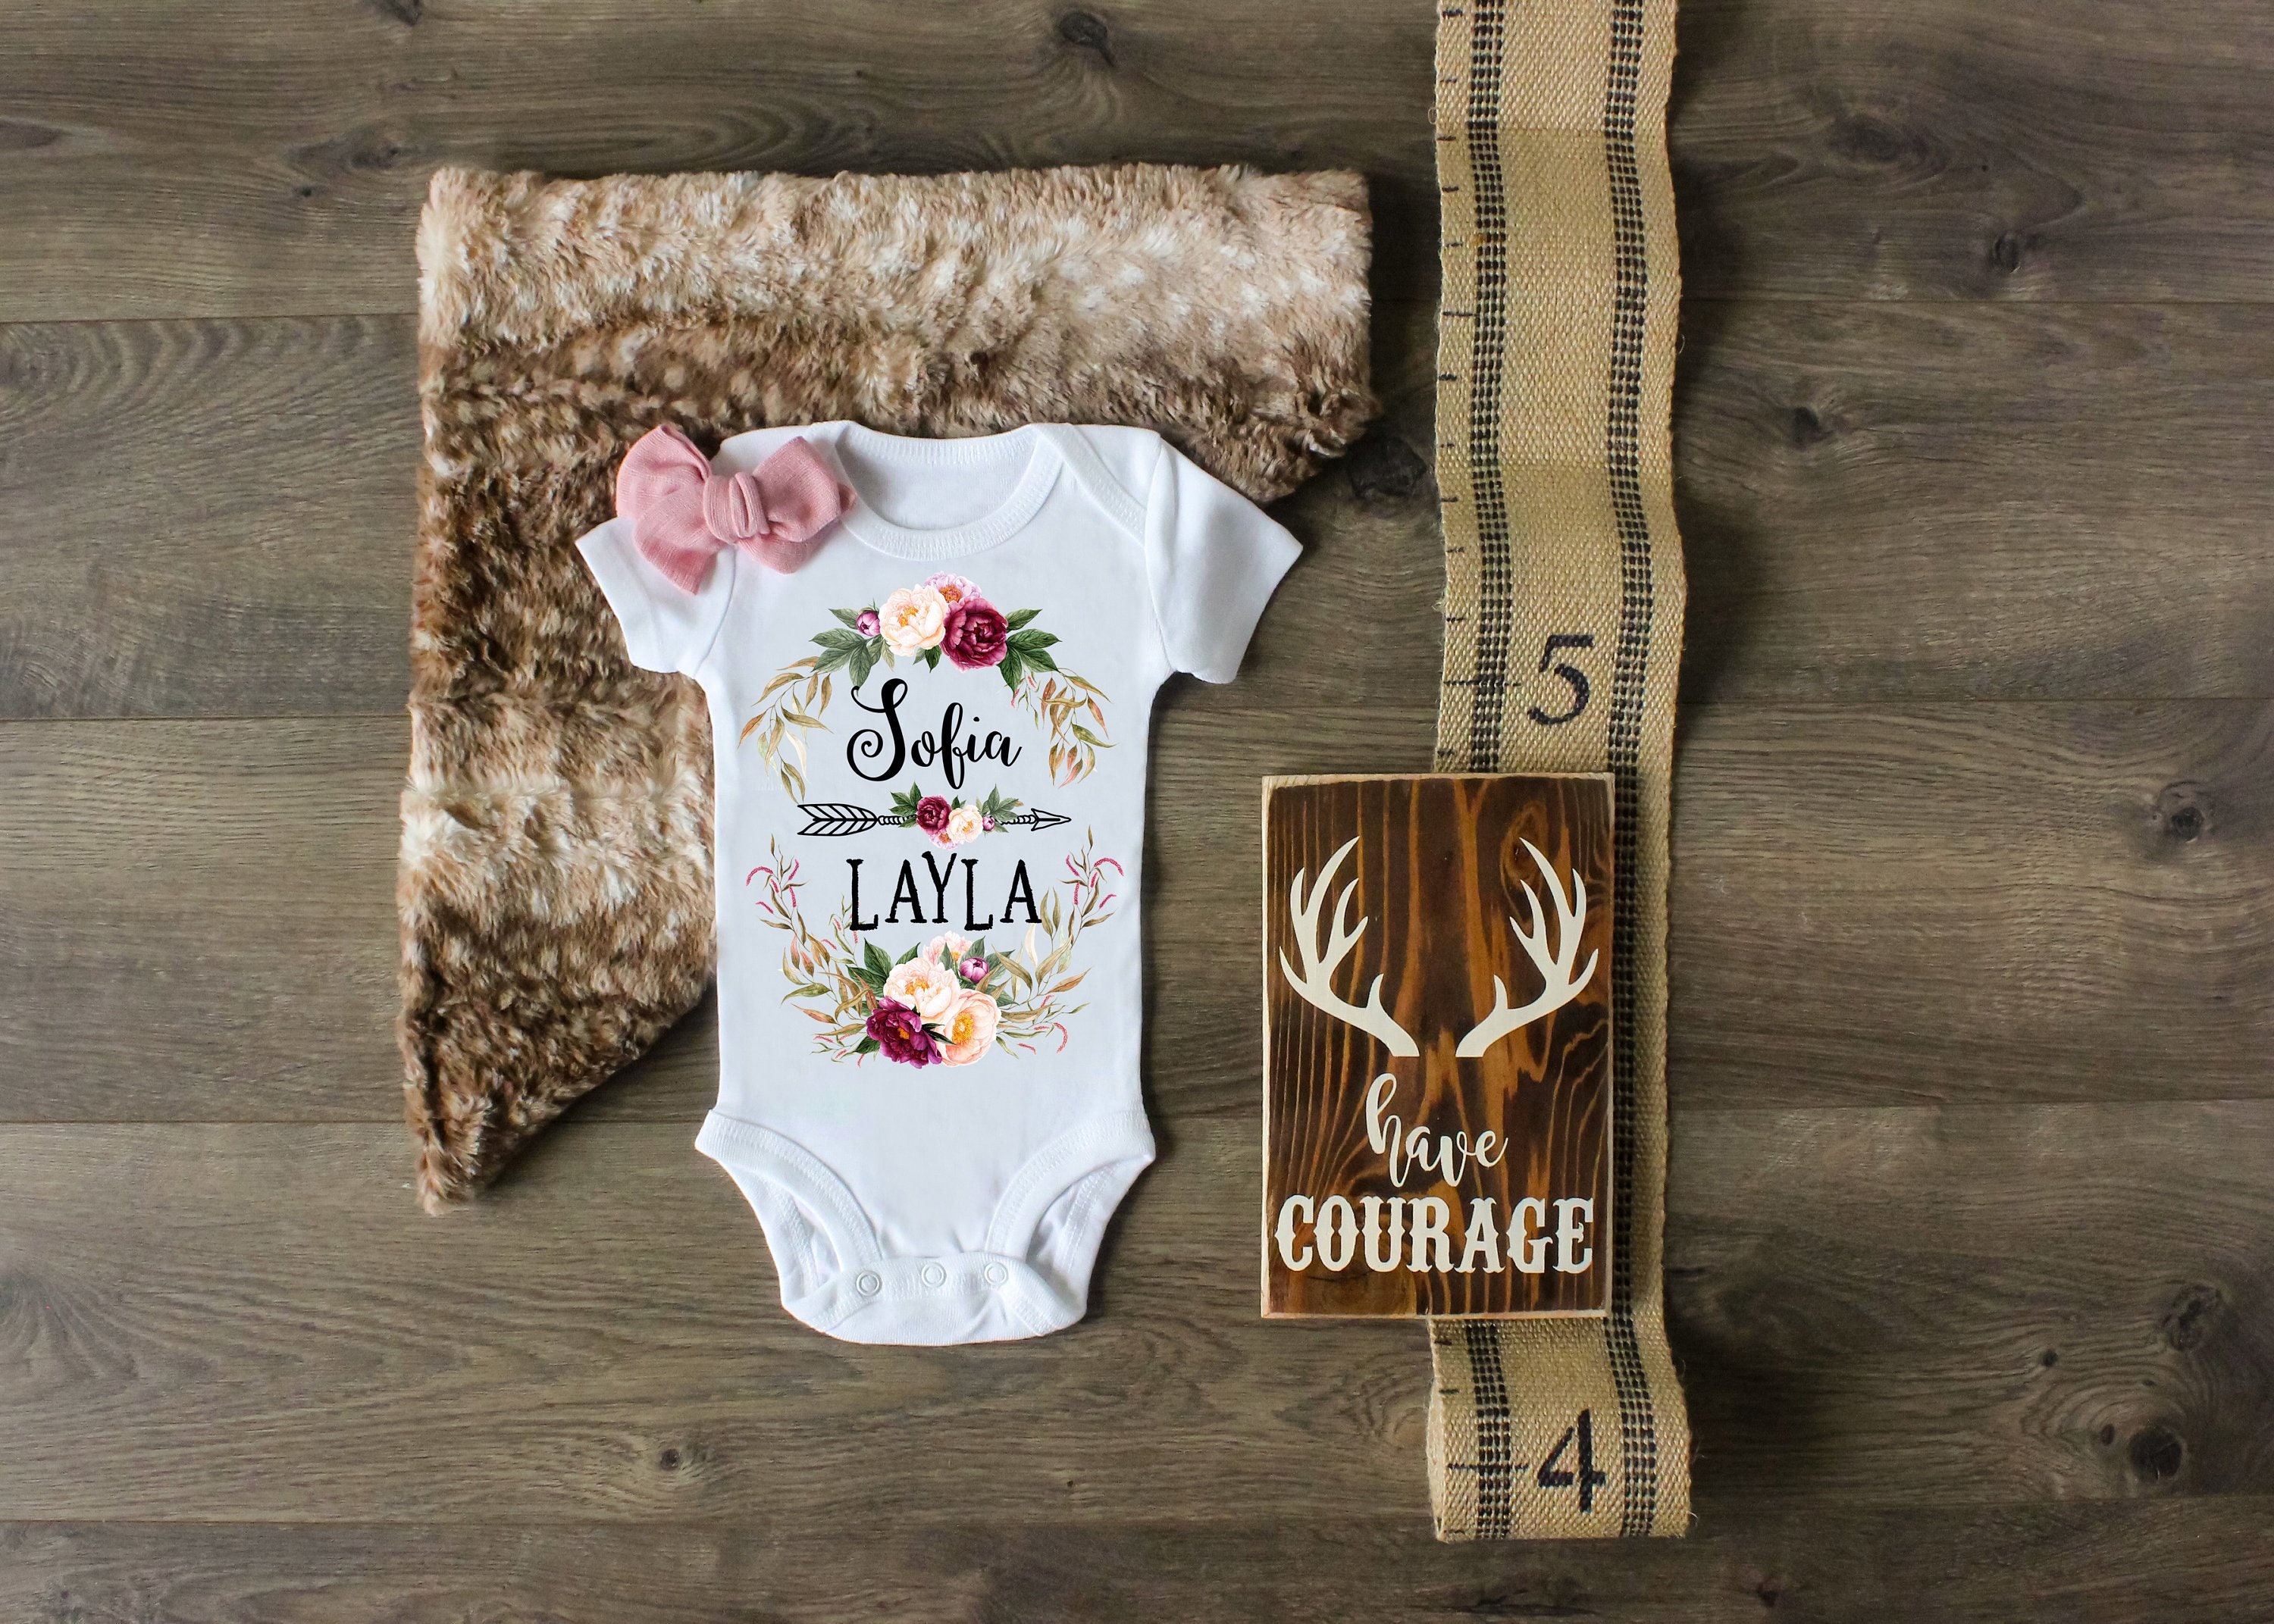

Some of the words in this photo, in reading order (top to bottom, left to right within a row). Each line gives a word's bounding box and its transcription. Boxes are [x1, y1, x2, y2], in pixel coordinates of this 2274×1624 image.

[1527, 634, 1594, 725] 5
[847, 678, 1023, 789] Sofia
[846, 850, 1042, 931] LAYLA
[1366, 1073, 1508, 1187] have
[1275, 1194, 1594, 1274] COURAGE
[1536, 1408, 1606, 1514] 4
